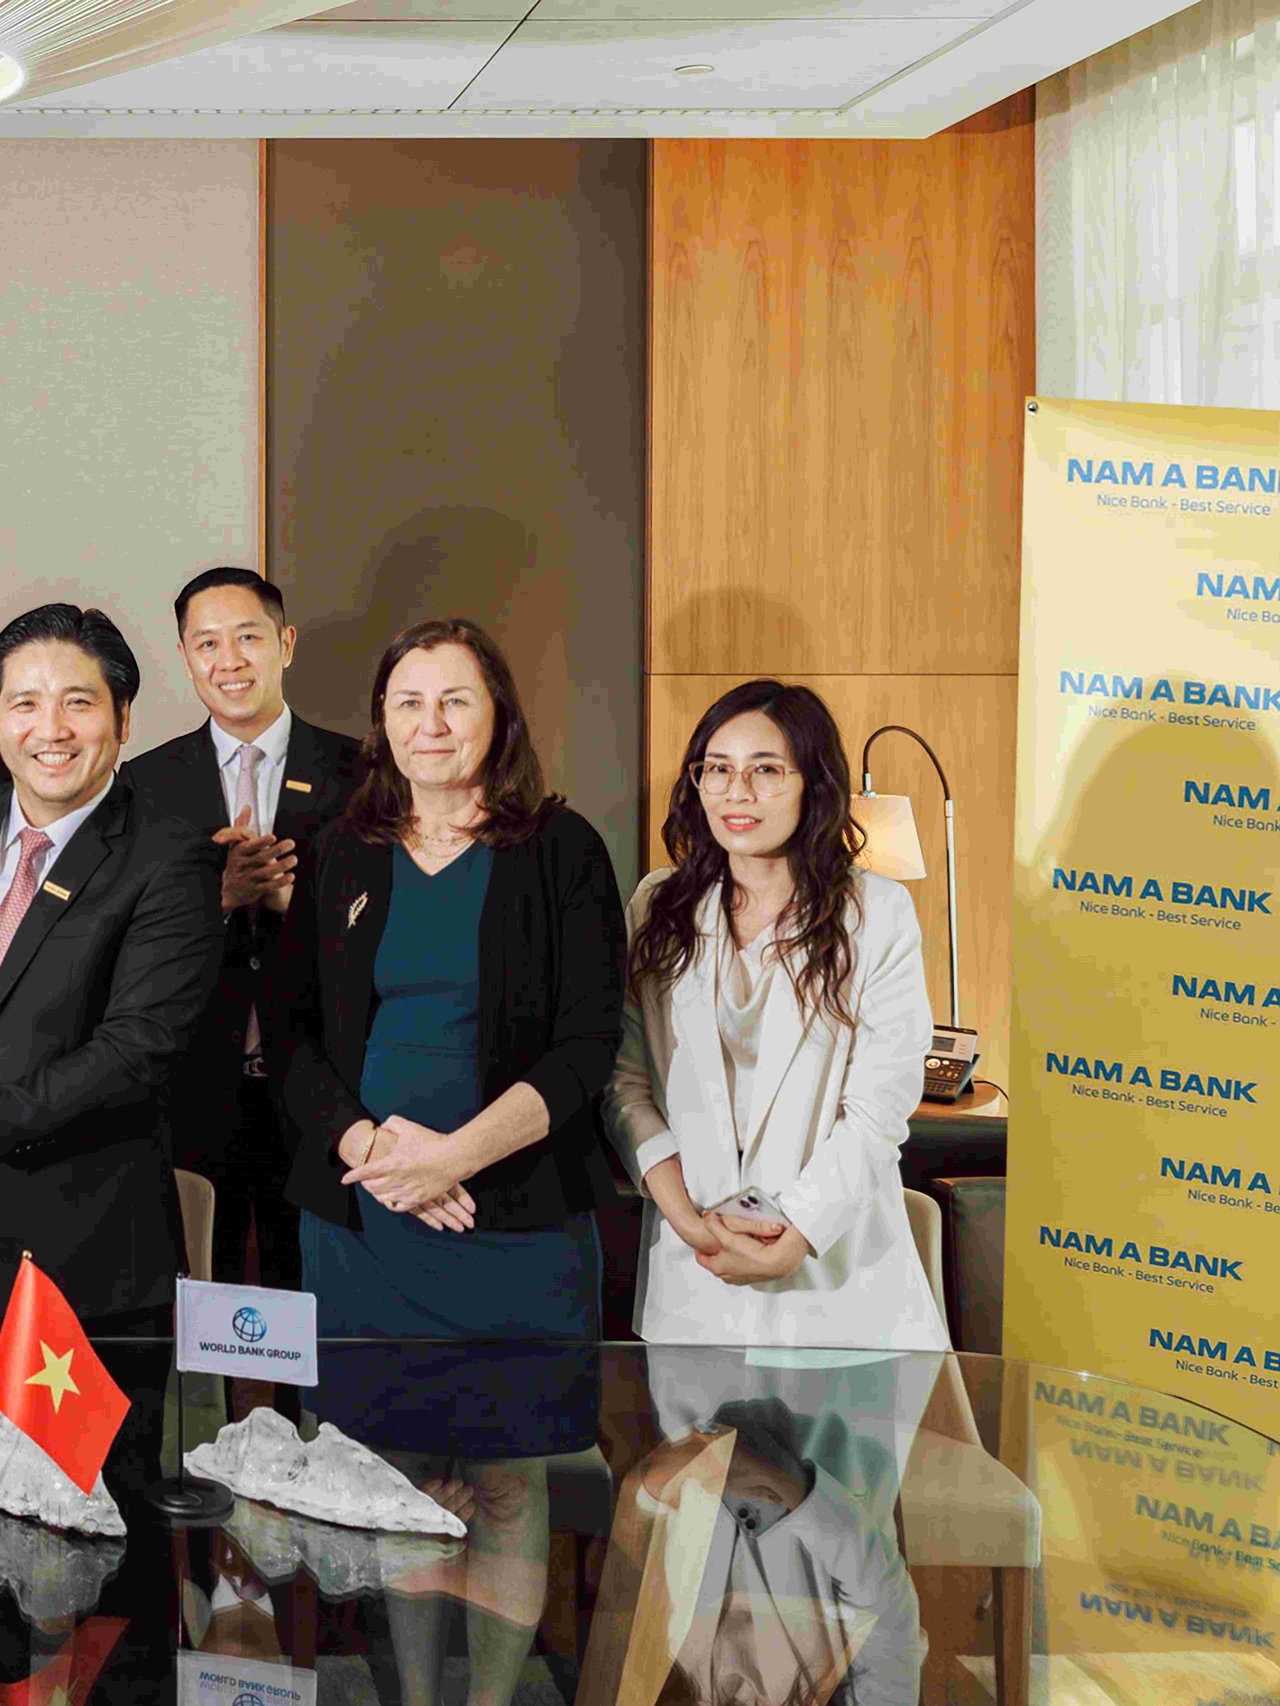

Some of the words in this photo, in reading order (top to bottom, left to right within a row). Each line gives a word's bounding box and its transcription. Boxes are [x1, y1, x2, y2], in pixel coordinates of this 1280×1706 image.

[1067, 458, 1154, 486] NAM
[1161, 463, 1187, 488] A
[1196, 465, 1280, 493] BAN
[1097, 494, 1127, 507] Nice
[1131, 495, 1166, 509] Bank
[1180, 498, 1212, 512] Best
[1216, 501, 1271, 515] Service
[1226, 609, 1258, 621] Nice
[1060, 671, 1143, 700] NAM
[1150, 679, 1175, 703] A
[1088, 705, 1117, 718] Nice
[1122, 707, 1156, 722] Bank
[1168, 711, 1200, 726] Best
[1202, 715, 1255, 730] Service
[1184, 780, 1270, 810] NAM
[1213, 815, 1243, 828] Nice
[1053, 868, 1132, 897] NAM
[1139, 878, 1163, 901] A
[1171, 881, 1271, 914] BANK
[1080, 901, 1108, 914] Nice
[1111, 904, 1145, 918] Bank
[1157, 910, 1187, 924] Best
[1190, 914, 1241, 930] Service
[1172, 974, 1255, 1005] NAM
[1261, 987, 1280, 1008] A
[1200, 1008, 1229, 1021] Nice
[1233, 1012, 1267, 1026] Bank
[1046, 1052, 1123, 1083] NAM
[1128, 1066, 1152, 1087] A
[1160, 1069, 1257, 1103] BANK
[1072, 1084, 1099, 1097] Nice
[1102, 1089, 1134, 1103] Bank
[1146, 1095, 1174, 1109] Best
[1179, 1100, 1227, 1117] Service
[1160, 1157, 1241, 1189] NAM
[1247, 1172, 1271, 1194] A
[1188, 1189, 1216, 1202] Nice
[1219, 1194, 1253, 1209] Bank
[1039, 1225, 1113, 1257] NAM
[1119, 1242, 1142, 1263] A
[1149, 1245, 1243, 1281] BANK
[1064, 1257, 1090, 1271] Nice
[1093, 1262, 1124, 1277] Bank
[1136, 1270, 1163, 1284] Best
[1166, 1275, 1214, 1293] Service
[199, 1342, 236, 1354] WORLD
[238, 1345, 266, 1357] BANK
[266, 1349, 301, 1361] GROUP
[1149, 1328, 1227, 1361] NAM
[1233, 1346, 1256, 1367] A
[1176, 1359, 1203, 1373] Nice
[1206, 1365, 1238, 1380] Bank
[1250, 1374, 1278, 1389] Best
